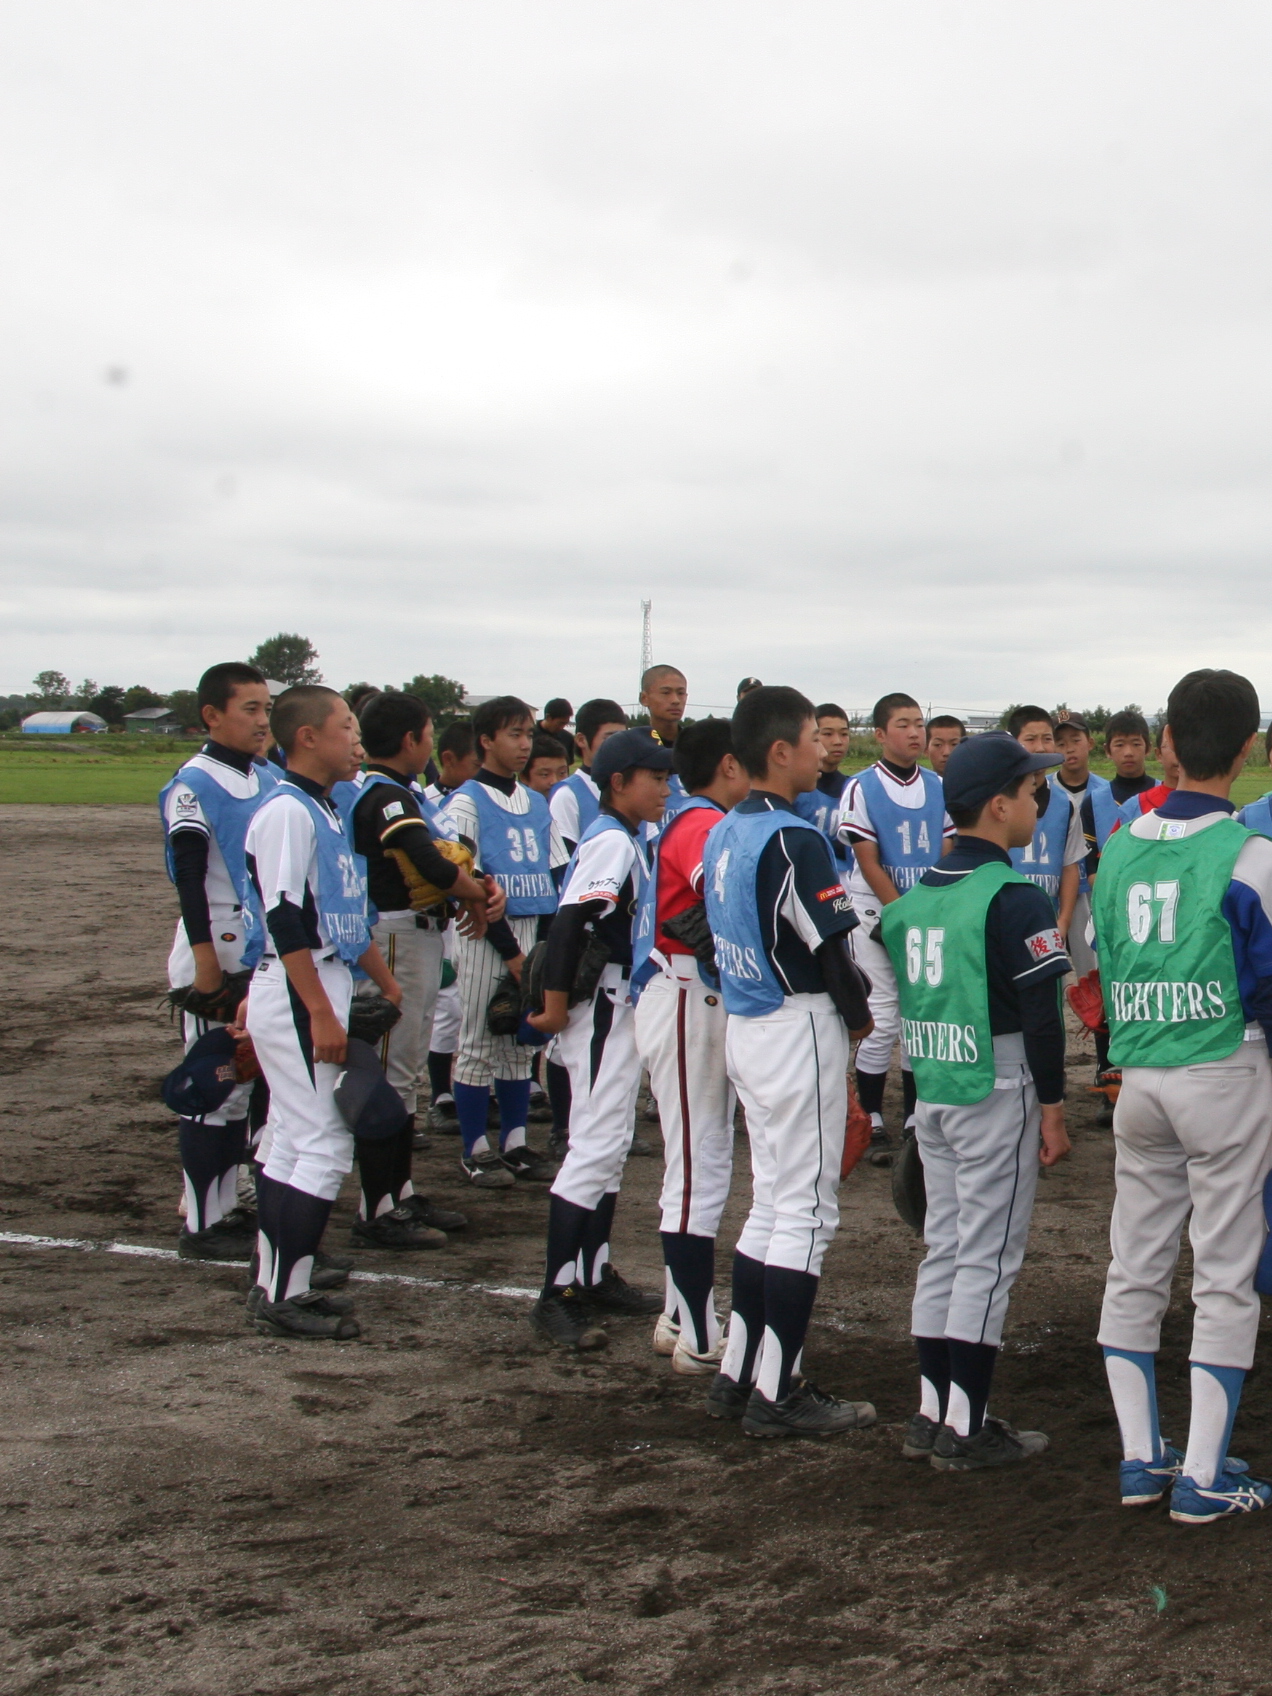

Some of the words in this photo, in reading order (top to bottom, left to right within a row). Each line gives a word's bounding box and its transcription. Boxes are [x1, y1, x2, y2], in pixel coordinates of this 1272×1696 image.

[506, 827, 540, 863] 35
[897, 820, 930, 855] 14
[1126, 879, 1180, 945] 67
[905, 926, 946, 988] 65
[900, 1017, 978, 1063] GHTERS
